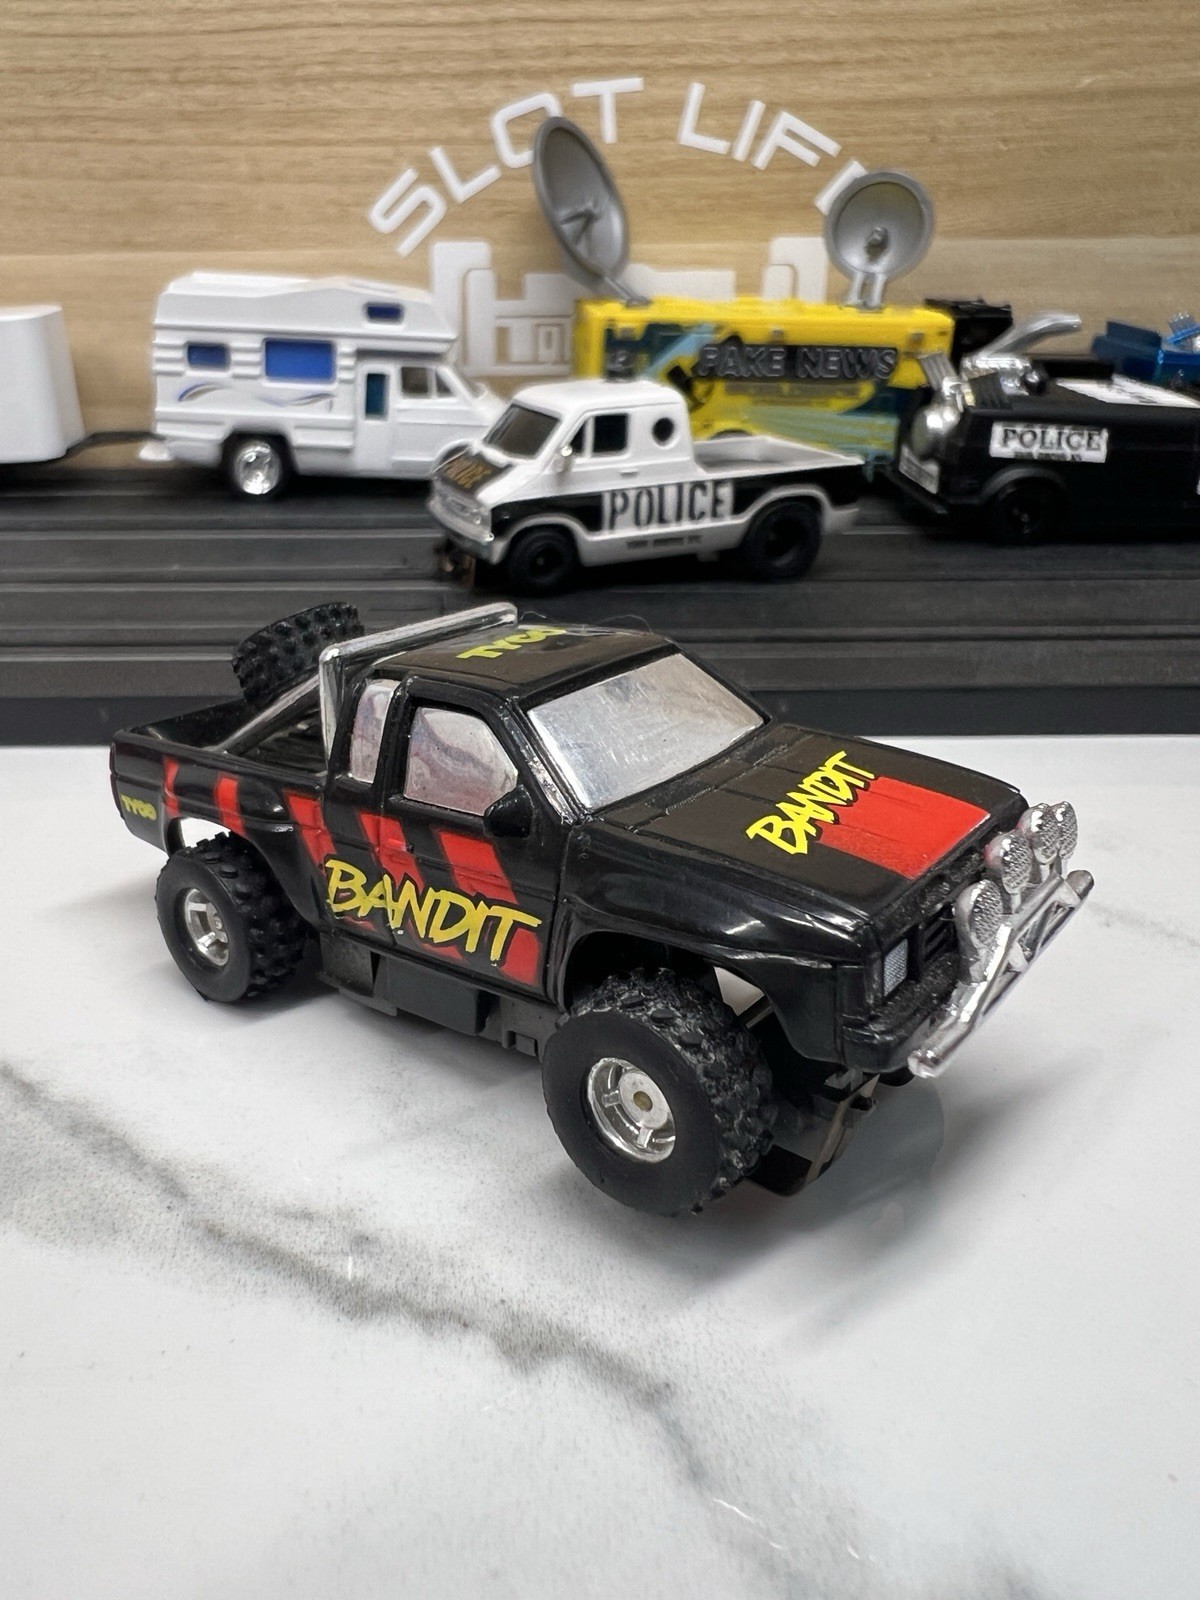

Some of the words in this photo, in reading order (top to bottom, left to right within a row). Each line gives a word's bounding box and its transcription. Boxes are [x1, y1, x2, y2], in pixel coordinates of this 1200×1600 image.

[697, 345, 785, 378] FAKE
[798, 347, 897, 380] NEWS
[1001, 427, 1101, 451] POLICE
[607, 480, 732, 532] POLICE
[745, 750, 875, 855] BANDIT
[325, 859, 541, 964] BANDIT
